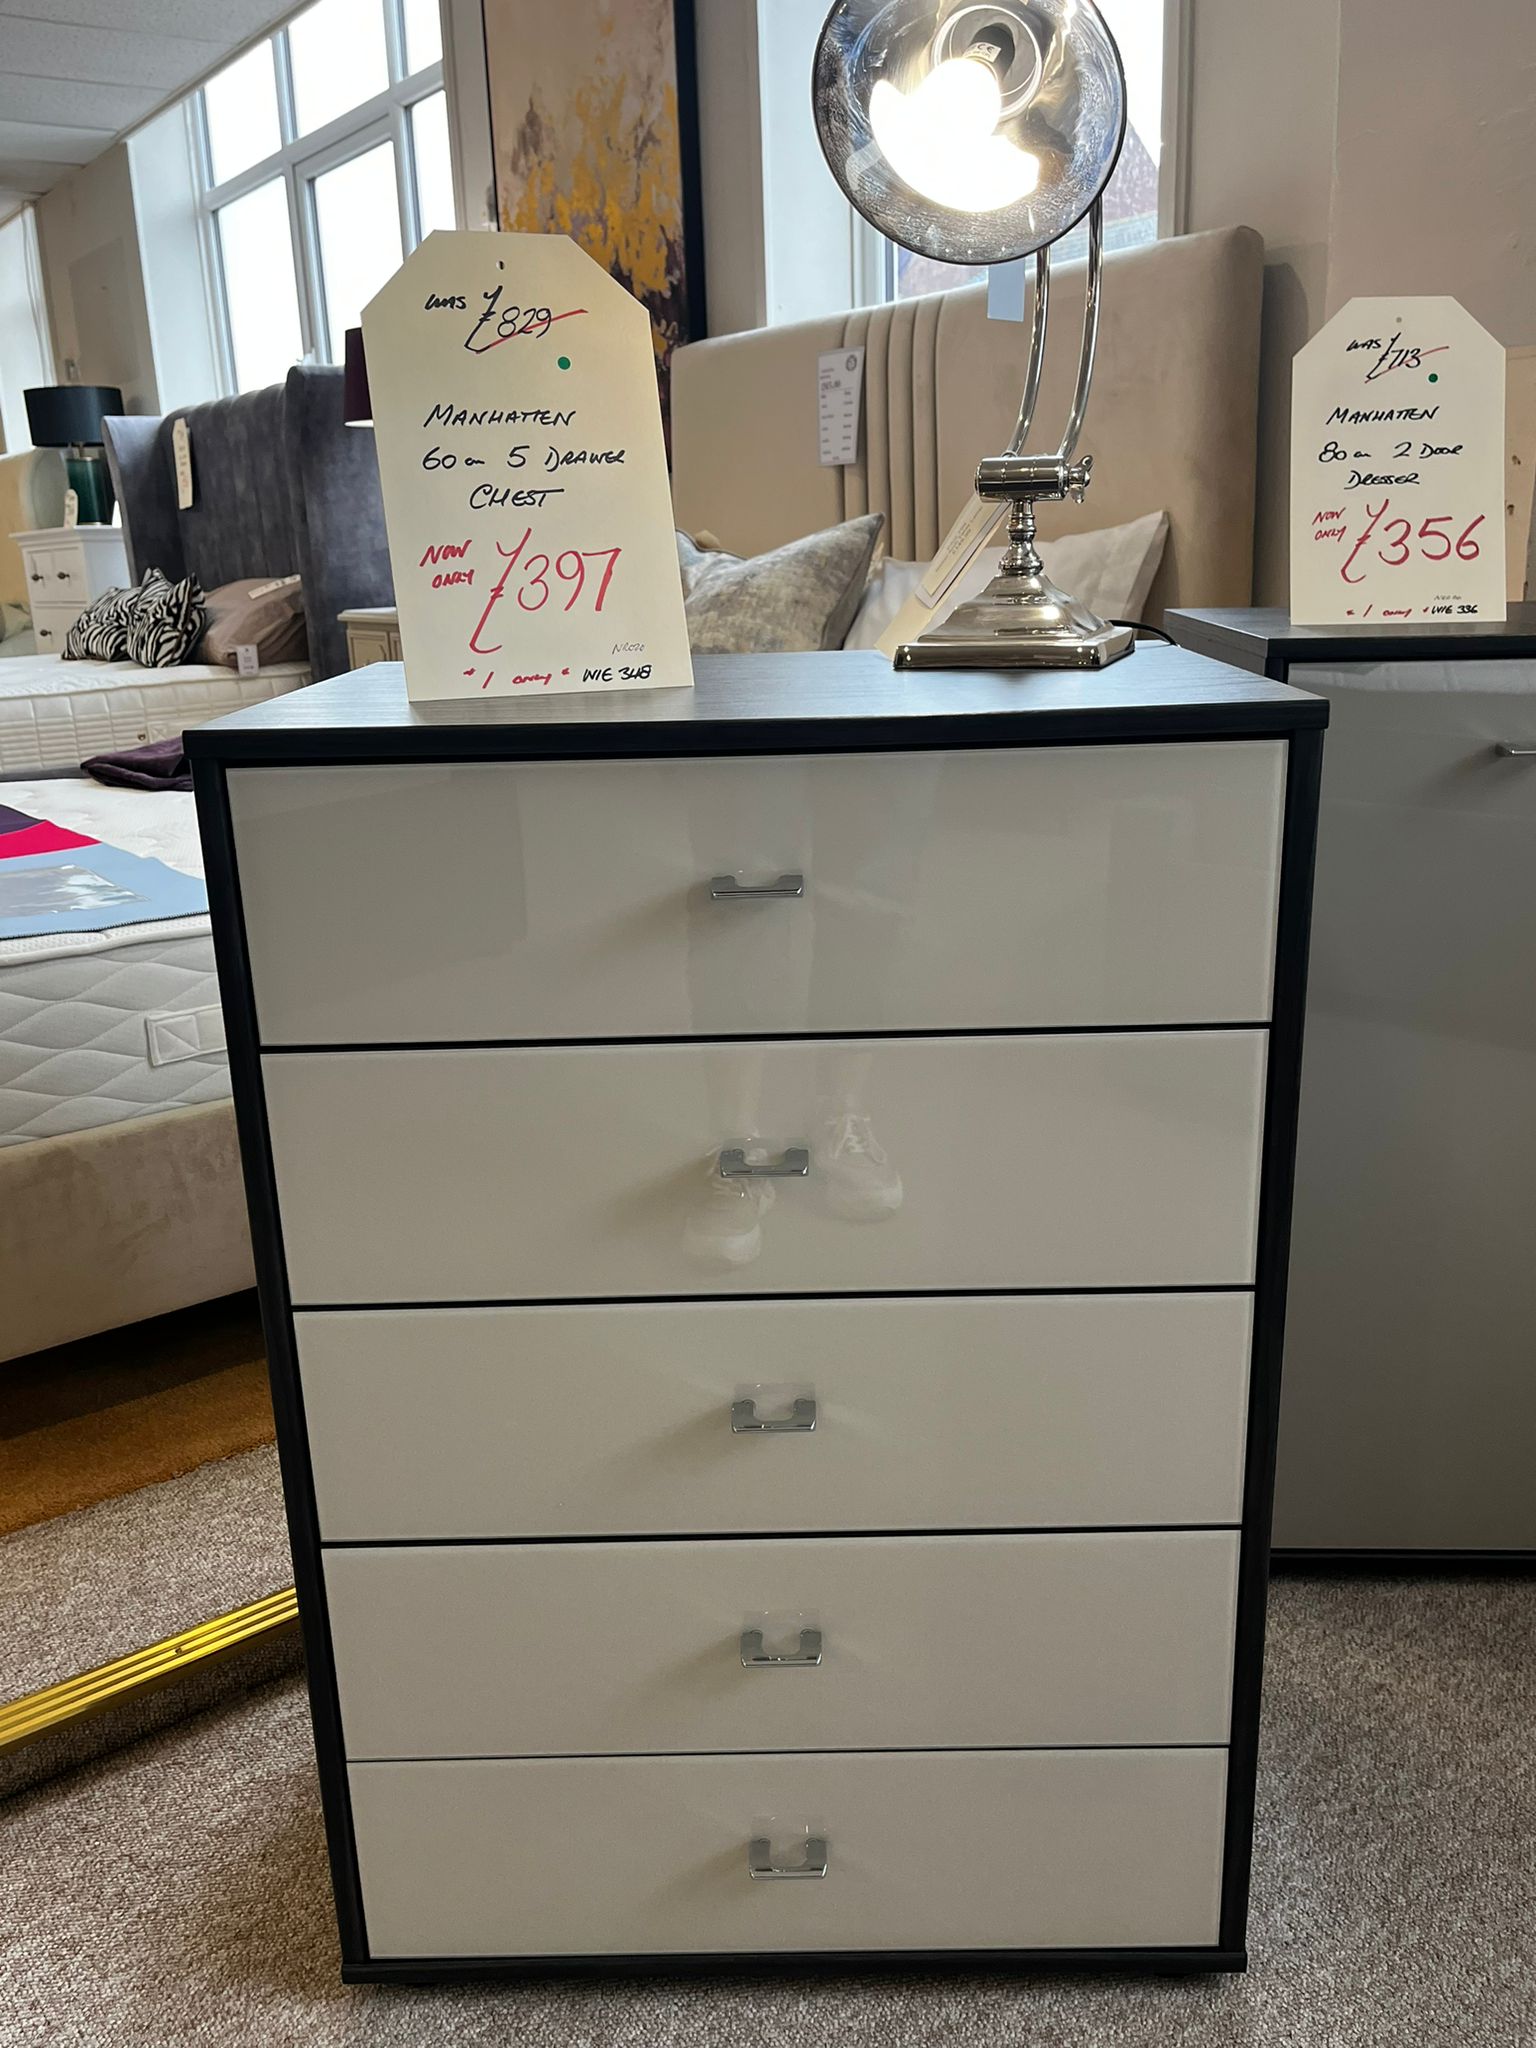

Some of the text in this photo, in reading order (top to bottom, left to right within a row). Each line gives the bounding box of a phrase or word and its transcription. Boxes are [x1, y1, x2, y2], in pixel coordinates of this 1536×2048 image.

[464, 285, 553, 353] £829
[1366, 332, 1421, 380] £713
[423, 404, 576, 428] MANHATTEN
[1326, 406, 1440, 425] MANHATTEN
[422, 447, 457, 470] 60
[507, 446, 530, 468] 5
[1318, 441, 1347, 463] 80
[1393, 441, 1412, 458] 2
[469, 484, 565, 509] CHEST
[1312, 507, 1346, 525] NOW
[1315, 526, 1347, 542] ONLY
[1340, 498, 1486, 584] £356
[419, 539, 472, 567] NOW
[469, 527, 622, 654] £397
[582, 667, 613, 682] WIE
[618, 664, 652, 680] 348
